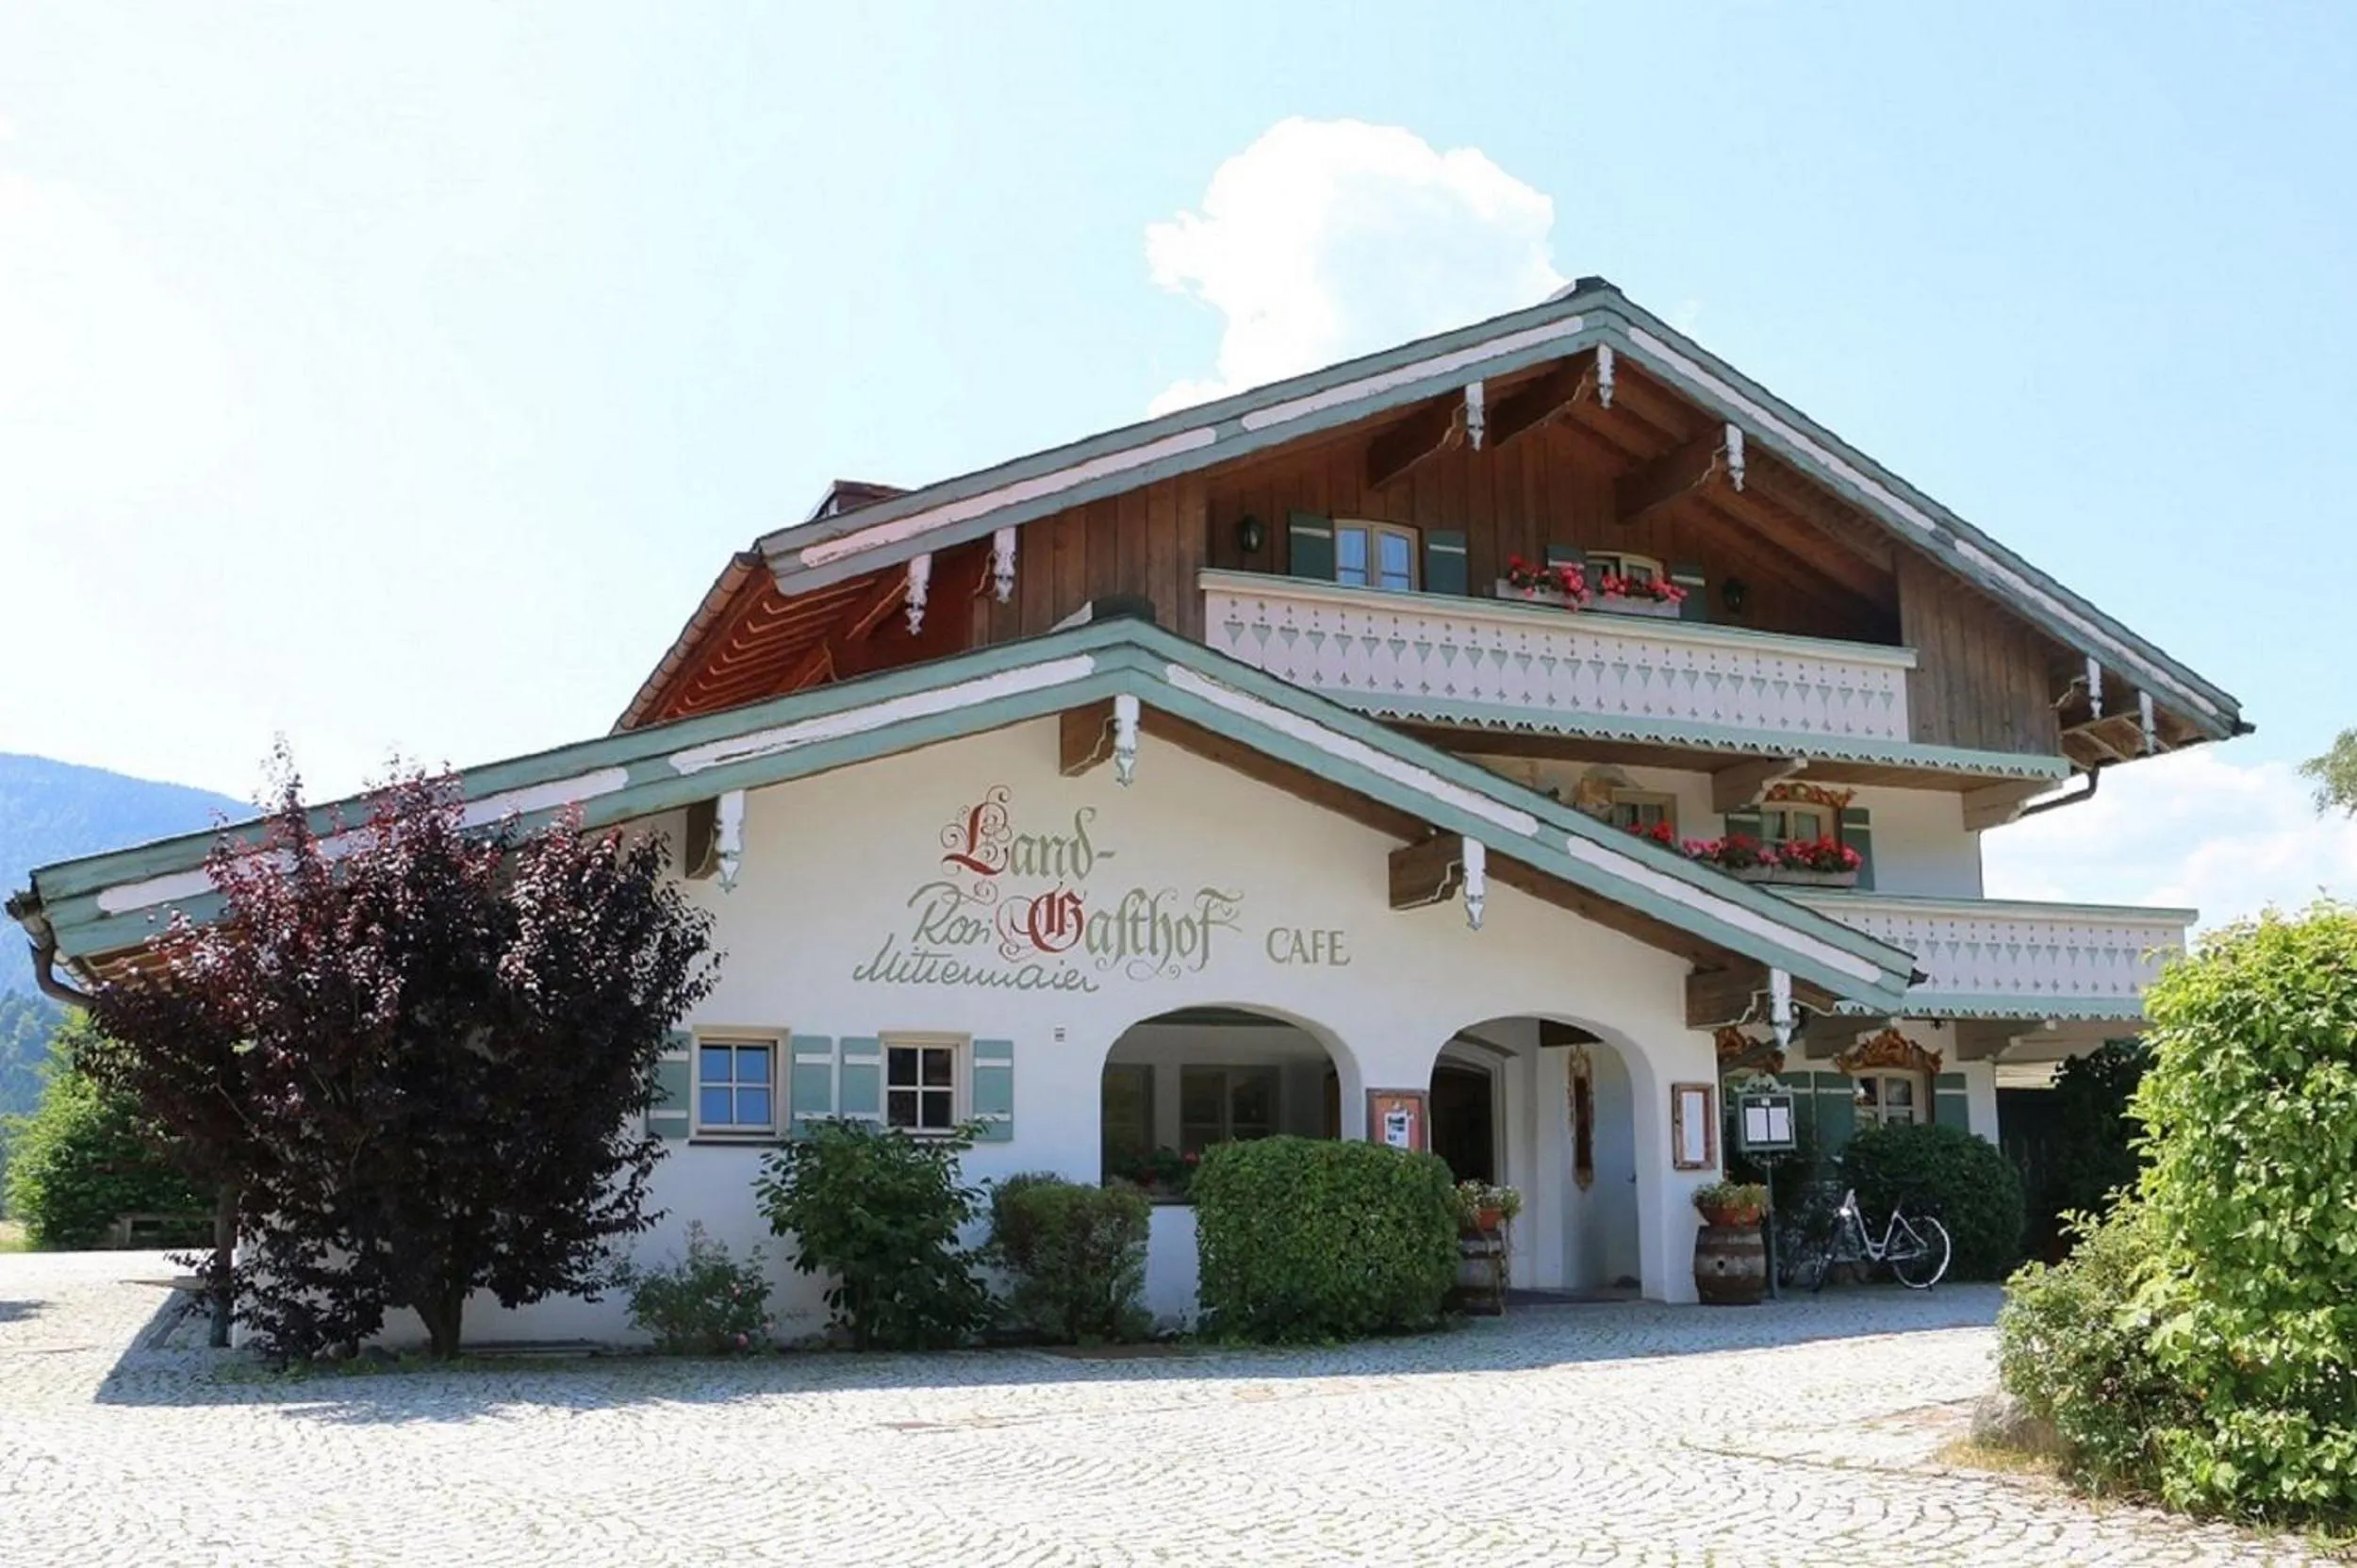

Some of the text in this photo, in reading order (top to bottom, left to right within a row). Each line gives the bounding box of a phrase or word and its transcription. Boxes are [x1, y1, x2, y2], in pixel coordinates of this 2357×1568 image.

[940, 785, 1116, 891] Land-
[907, 882, 993, 945] Rosi
[996, 882, 1244, 981] Gasthof
[852, 933, 1099, 993] Mittermaier
[1265, 926, 1352, 966] CAFE
